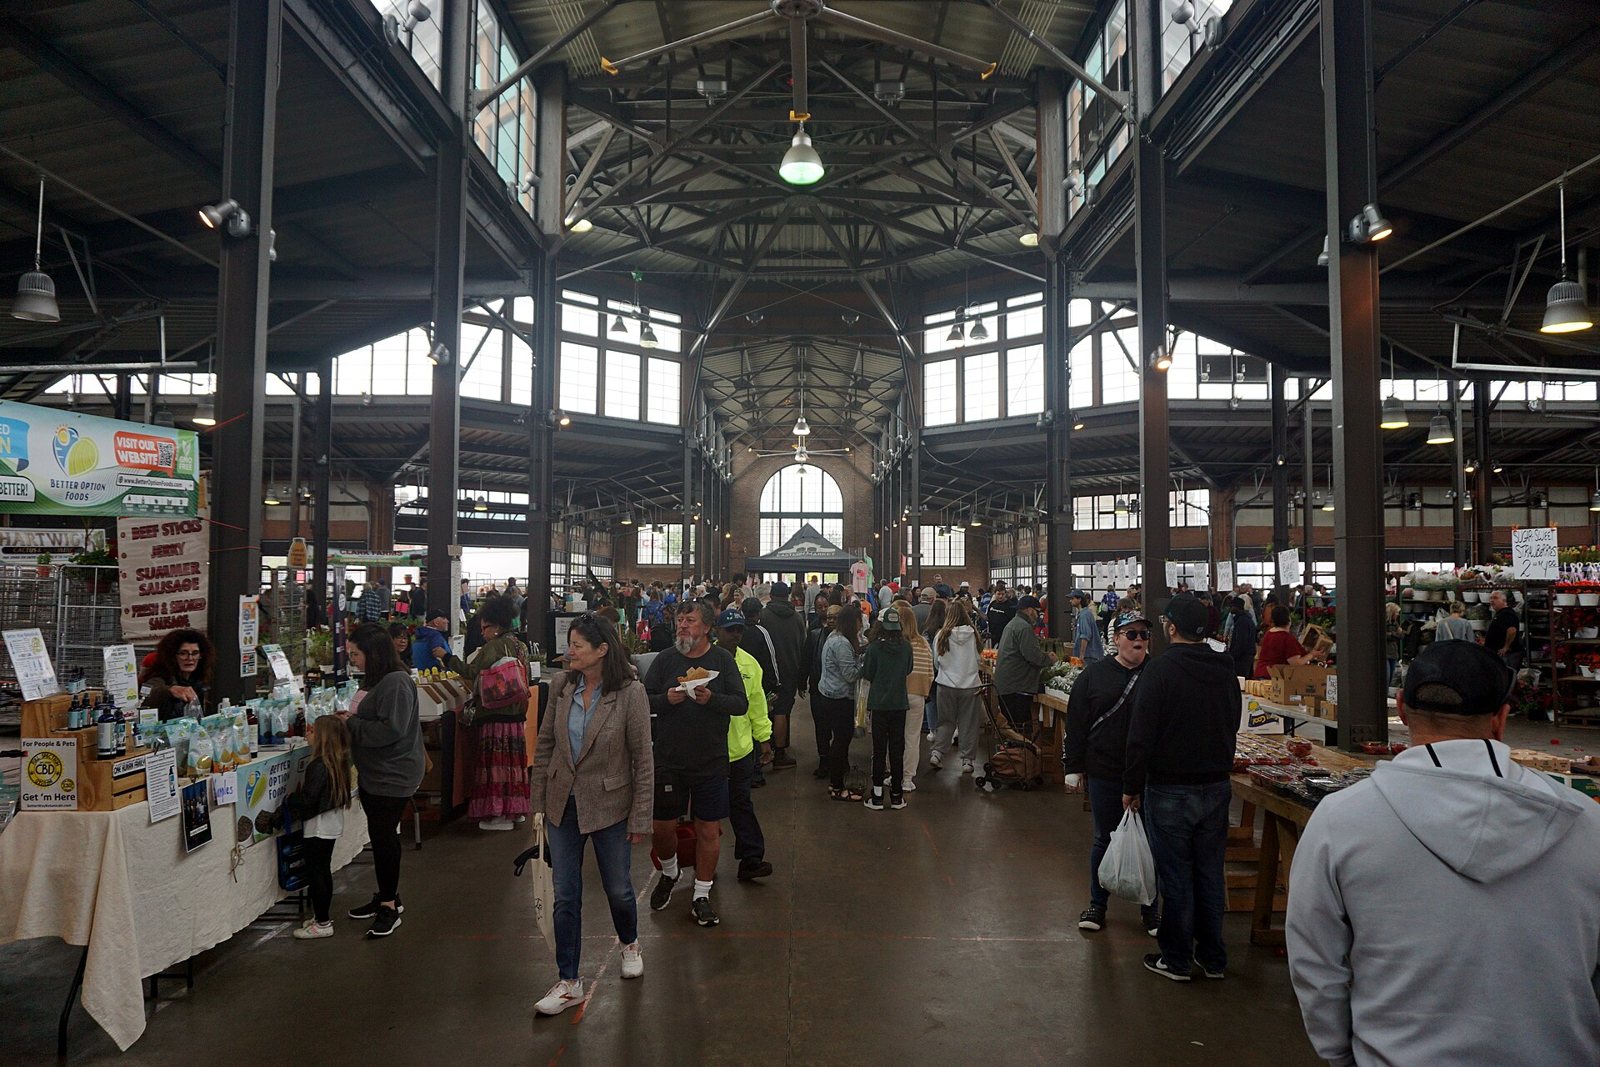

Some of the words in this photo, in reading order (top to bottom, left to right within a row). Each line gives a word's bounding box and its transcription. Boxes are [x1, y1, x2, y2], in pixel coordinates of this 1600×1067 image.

[116, 436, 138, 450] VISIT
[138, 439, 156, 451] OUR
[117, 451, 158, 466] WEBSITE
[0, 482, 28, 497] BETTER!
[50, 479, 79, 490] BETTER
[80, 481, 106, 491] OPTION
[65, 491, 89, 501] FOODS
[161, 519, 203, 536] STICKS
[151, 541, 186, 559] JERKY
[136, 561, 201, 582] SUMMER
[138, 578, 200, 597] SAUSAGE
[34, 740, 55, 748] People
[35, 764, 55, 775] CBD
[114, 764, 122, 774] ONE
[270, 760, 290, 774] BETTER
[268, 773, 290, 787] OPTION
[22, 793, 38, 801] Get
[55, 793, 76, 801] Here
[268, 785, 287, 800] FOODS
